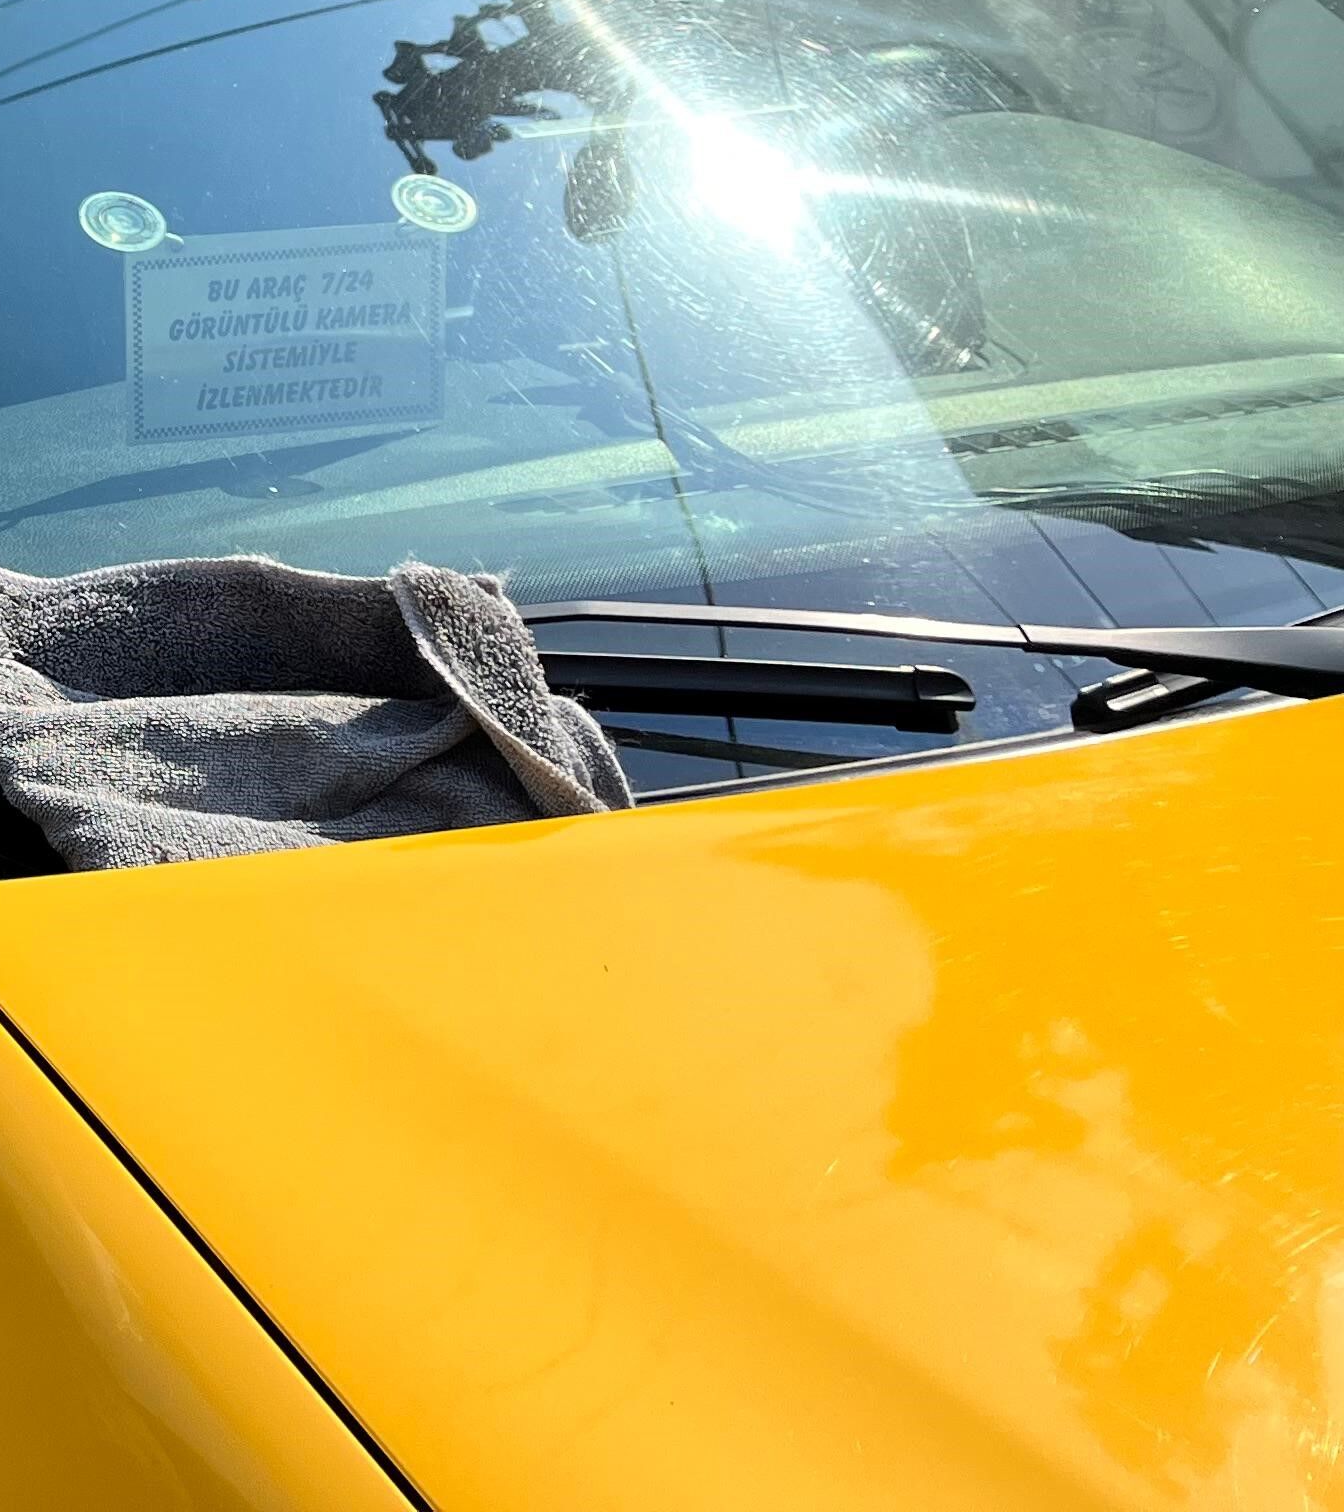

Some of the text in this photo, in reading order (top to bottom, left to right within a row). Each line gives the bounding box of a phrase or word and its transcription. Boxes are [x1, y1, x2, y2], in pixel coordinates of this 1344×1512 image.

[207, 269, 374, 304] BU ARAÇ 7/24
[169, 301, 412, 341] GÖRÜNTÜLÜ KAMERA
[223, 340, 359, 374] SİSTEMİYLE
[196, 373, 383, 411] İZLENMEKTEDİR
